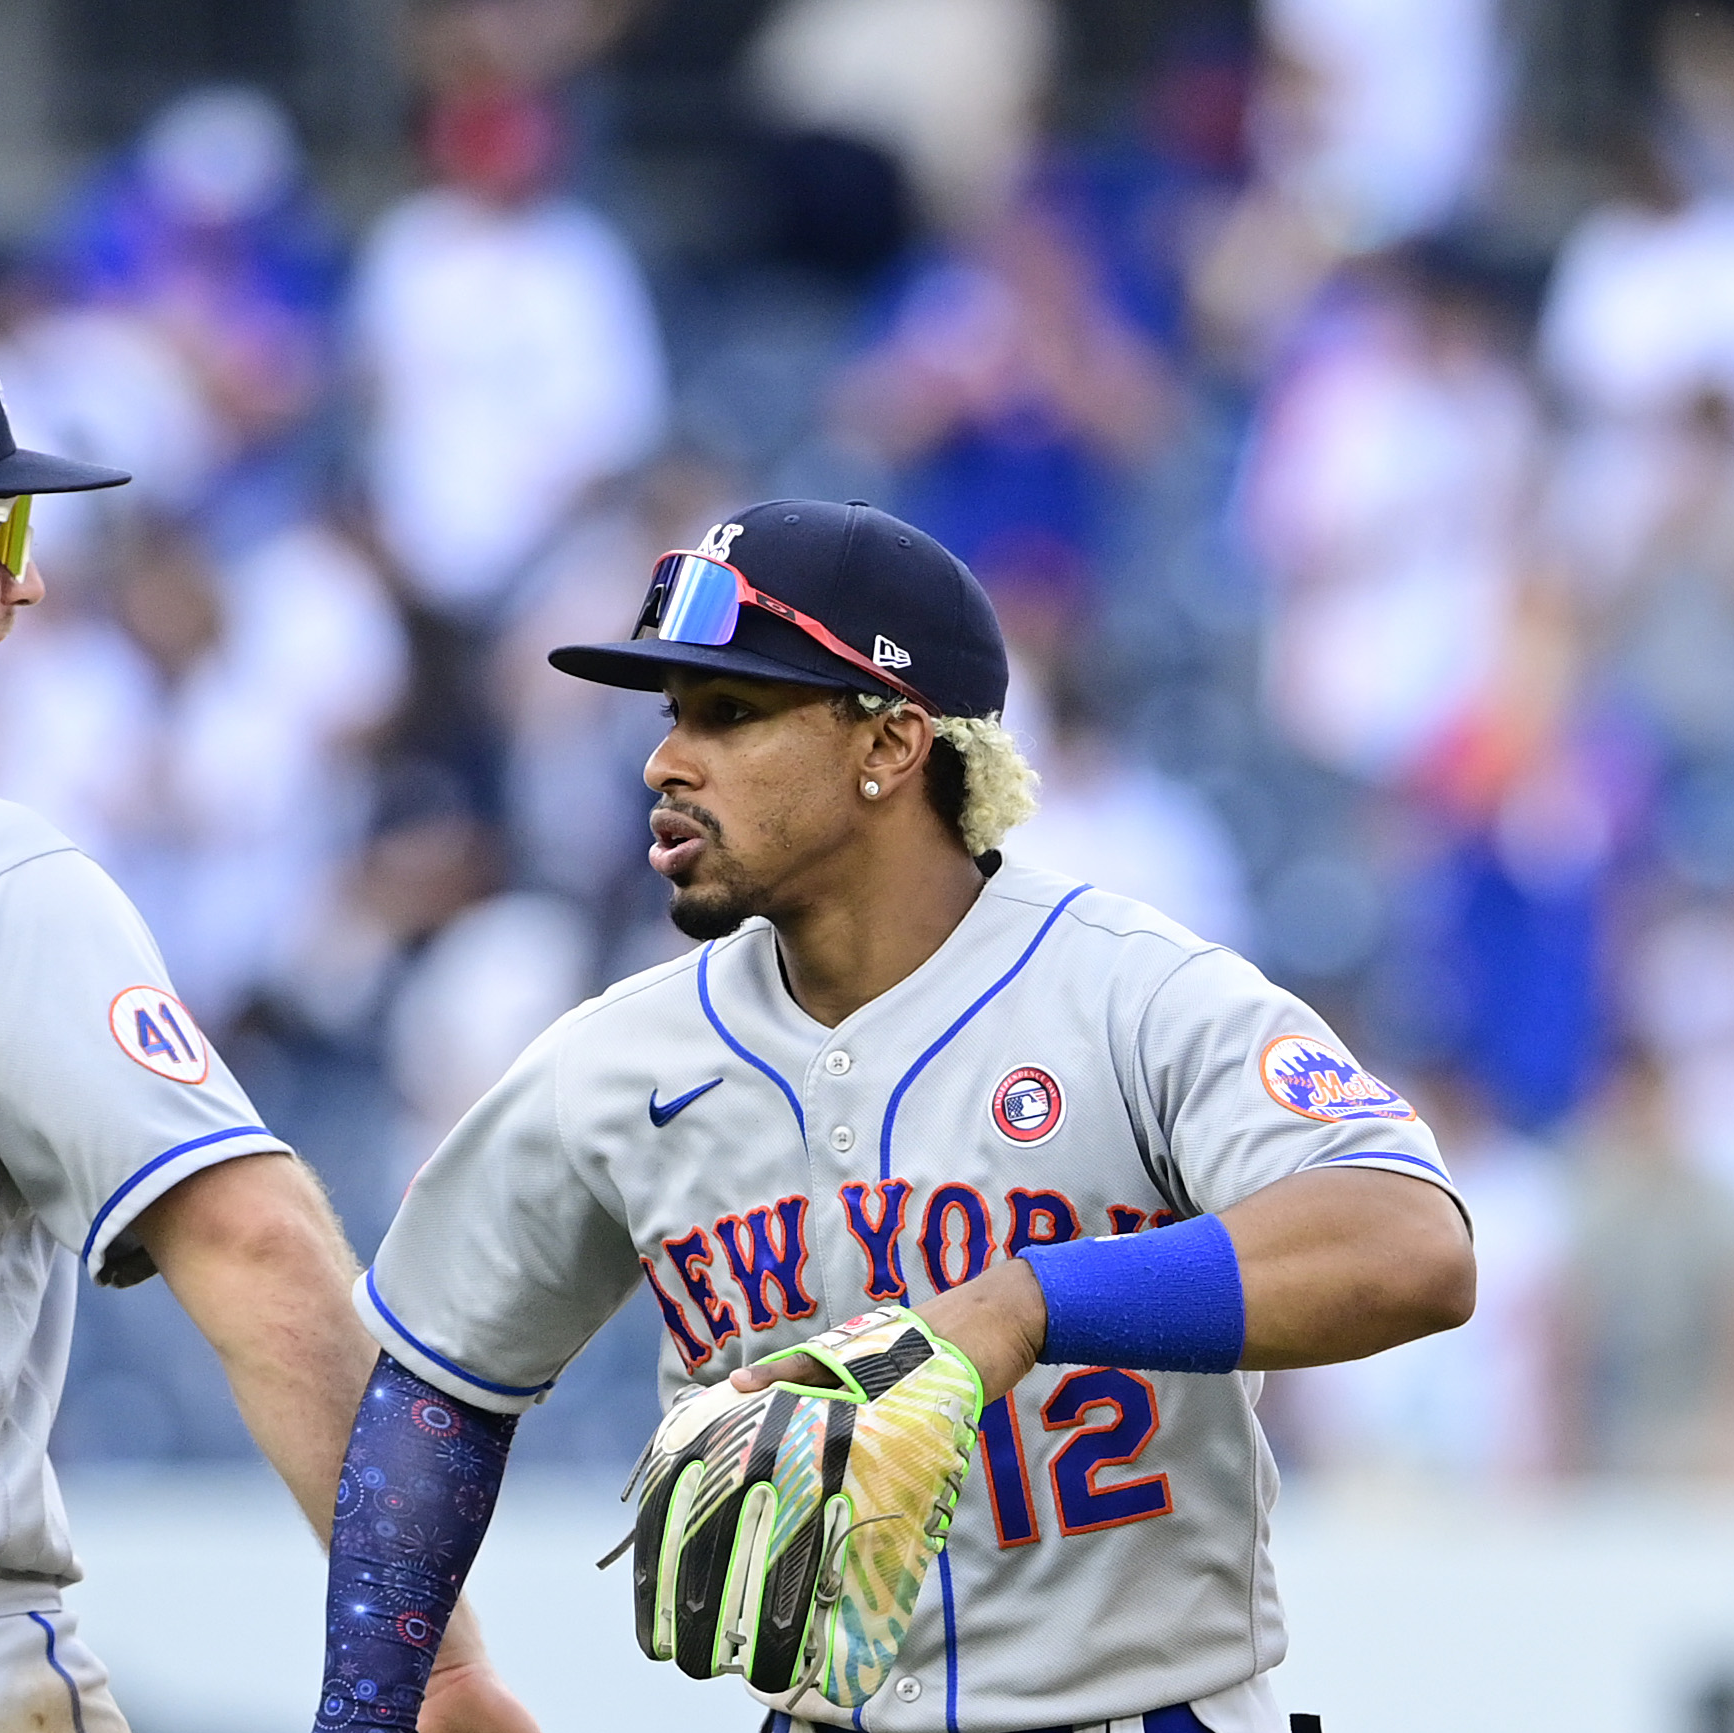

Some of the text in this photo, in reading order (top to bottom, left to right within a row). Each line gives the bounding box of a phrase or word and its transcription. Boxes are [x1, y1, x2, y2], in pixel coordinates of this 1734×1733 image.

[134, 1002, 198, 1063] 41
[1309, 1069, 1391, 1107] Mets
[837, 1177, 1175, 1302] YOR
[977, 1365, 1174, 1549] 12
